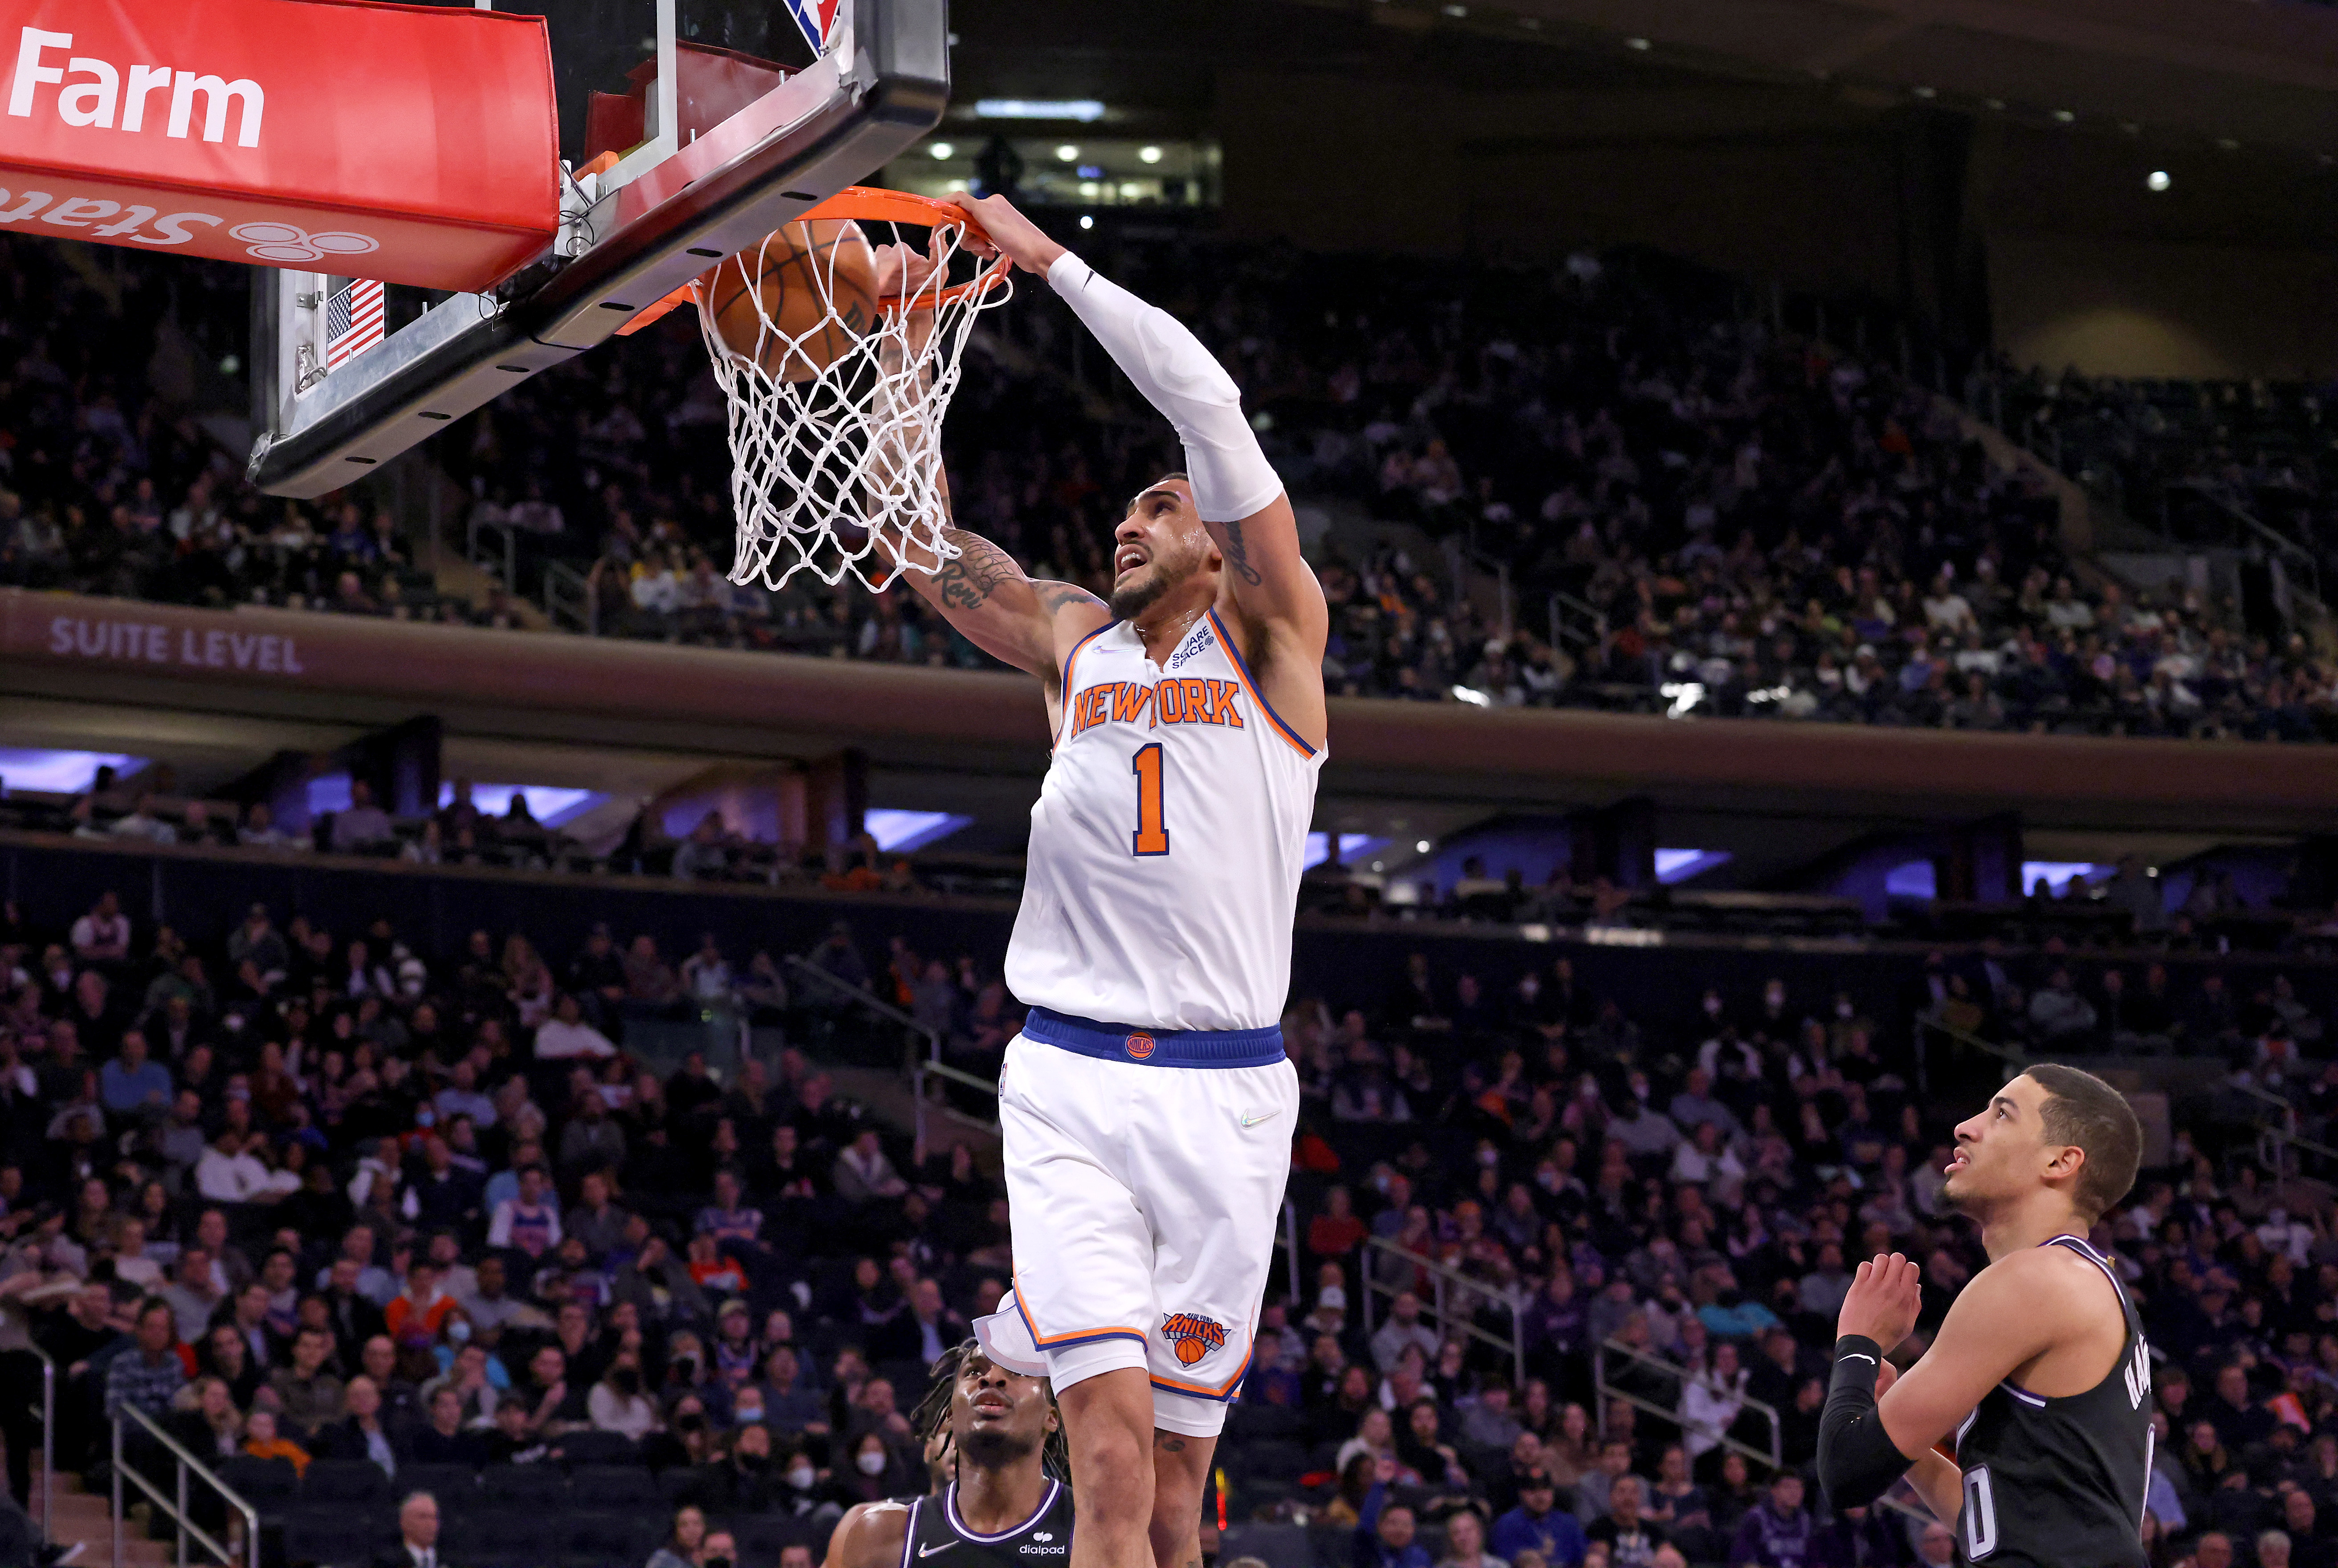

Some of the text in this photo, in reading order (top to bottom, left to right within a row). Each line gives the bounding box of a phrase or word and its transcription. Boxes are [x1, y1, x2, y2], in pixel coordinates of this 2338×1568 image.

[8, 26, 265, 148] Farm
[0, 187, 224, 245] Stat
[50, 616, 305, 675] SUITE LEVEL
[1070, 680, 1153, 742] NEW
[1132, 742, 1169, 857] 1
[1161, 1313, 1225, 1347] KNICKS
[1200, 1315, 1213, 1324] YORK
[1019, 1544, 1065, 1556] dialpad
